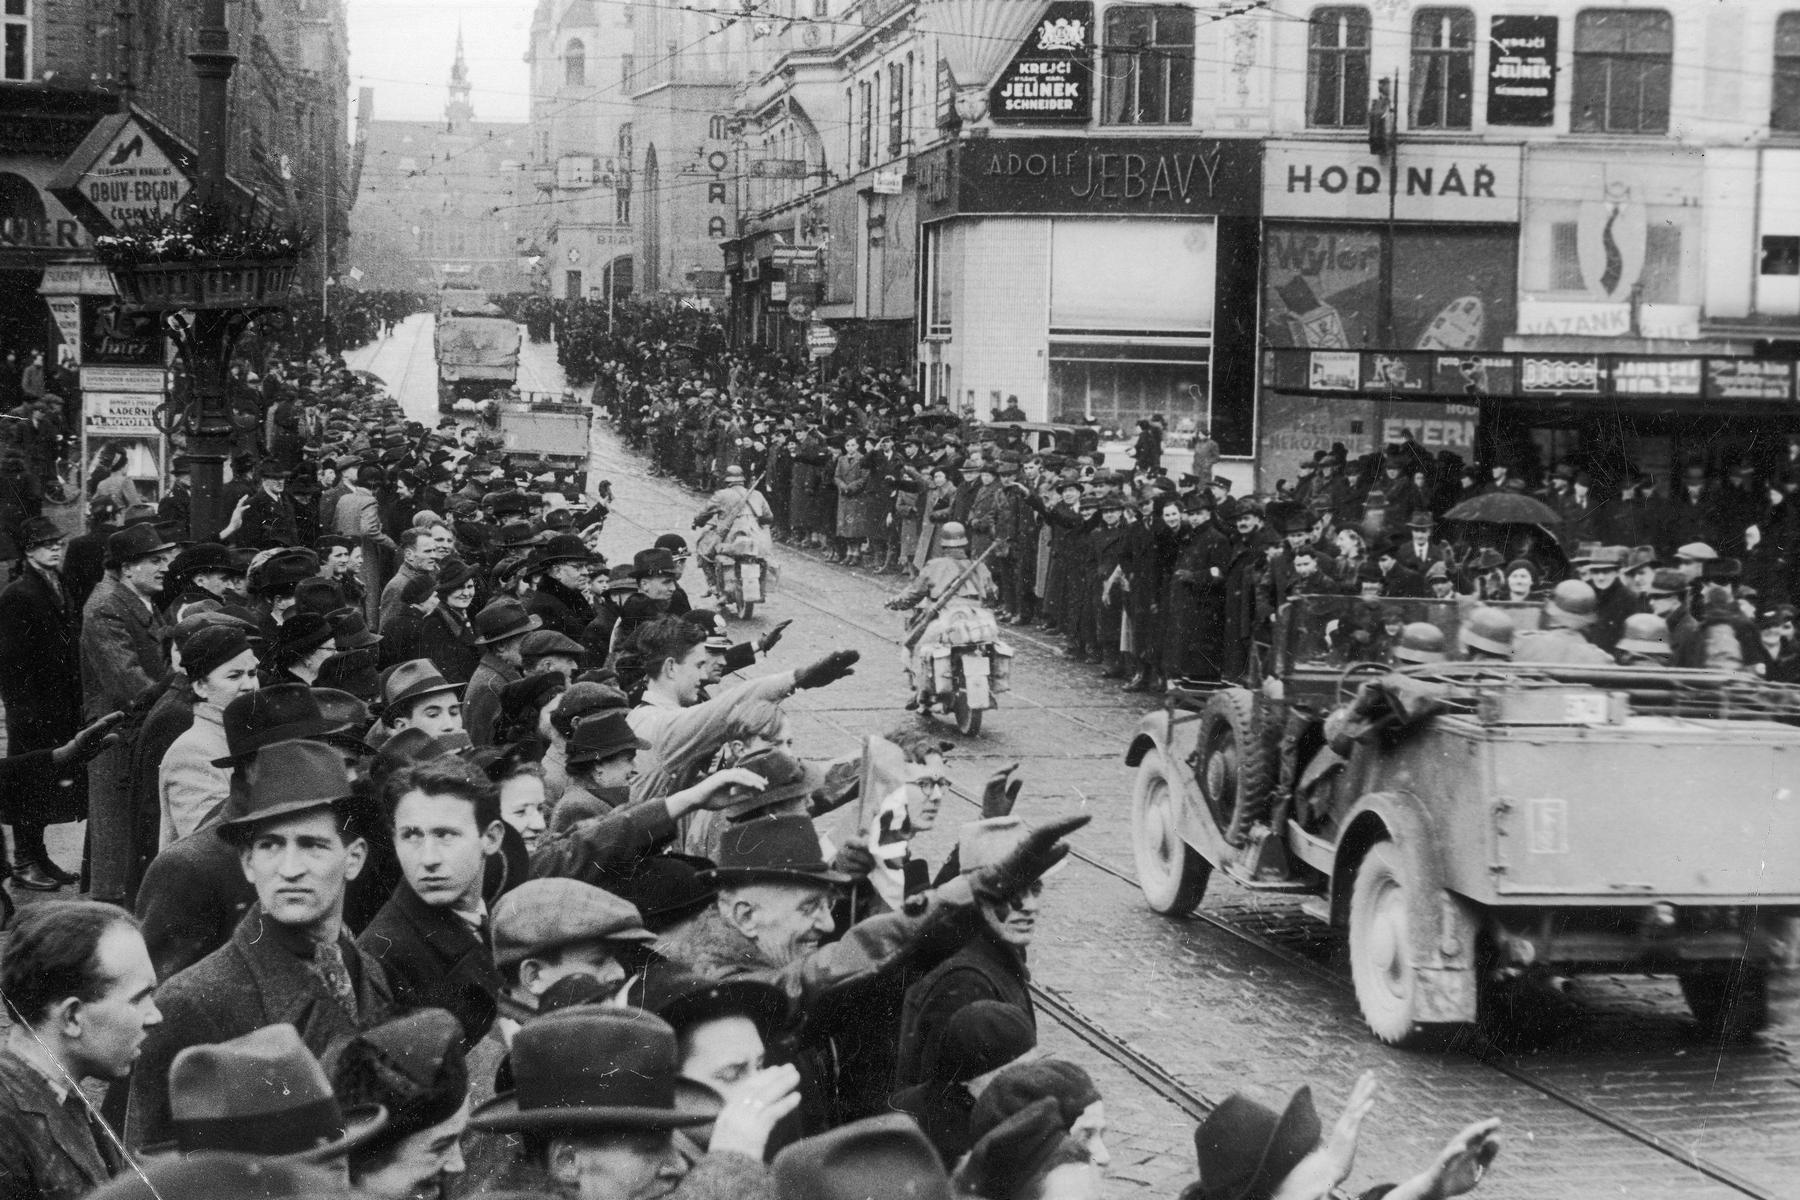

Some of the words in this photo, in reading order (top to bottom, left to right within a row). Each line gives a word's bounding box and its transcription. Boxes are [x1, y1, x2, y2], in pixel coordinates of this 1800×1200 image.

[1001, 80, 1079, 97] JELÍNEK
[1005, 99, 1074, 110] SCHNEIDER
[990, 151, 1078, 176] ADOLF
[1071, 141, 1221, 201] JEBAVÝ
